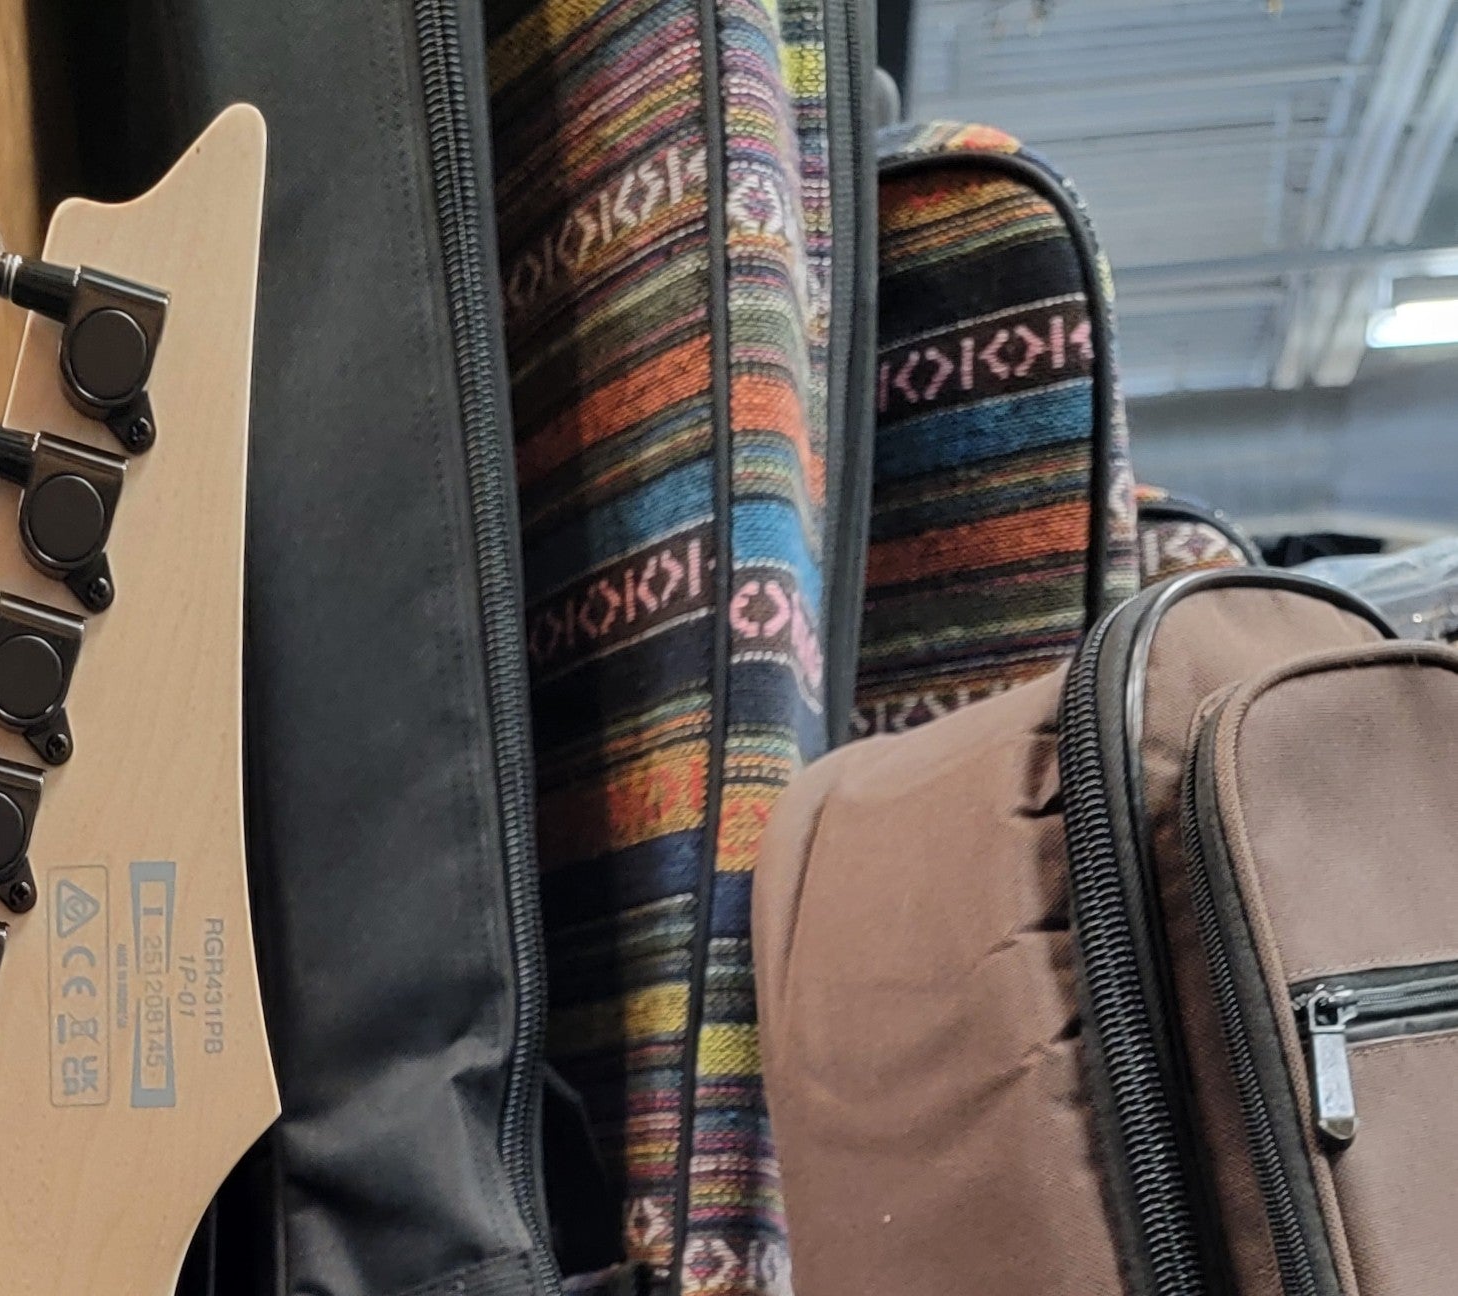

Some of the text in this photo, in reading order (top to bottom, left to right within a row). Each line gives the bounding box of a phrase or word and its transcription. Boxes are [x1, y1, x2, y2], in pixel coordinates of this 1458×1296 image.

[142, 934, 165, 1069] 251208145
[178, 954, 198, 1019] 1P-01
[203, 917, 225, 1055] RGR431PB
